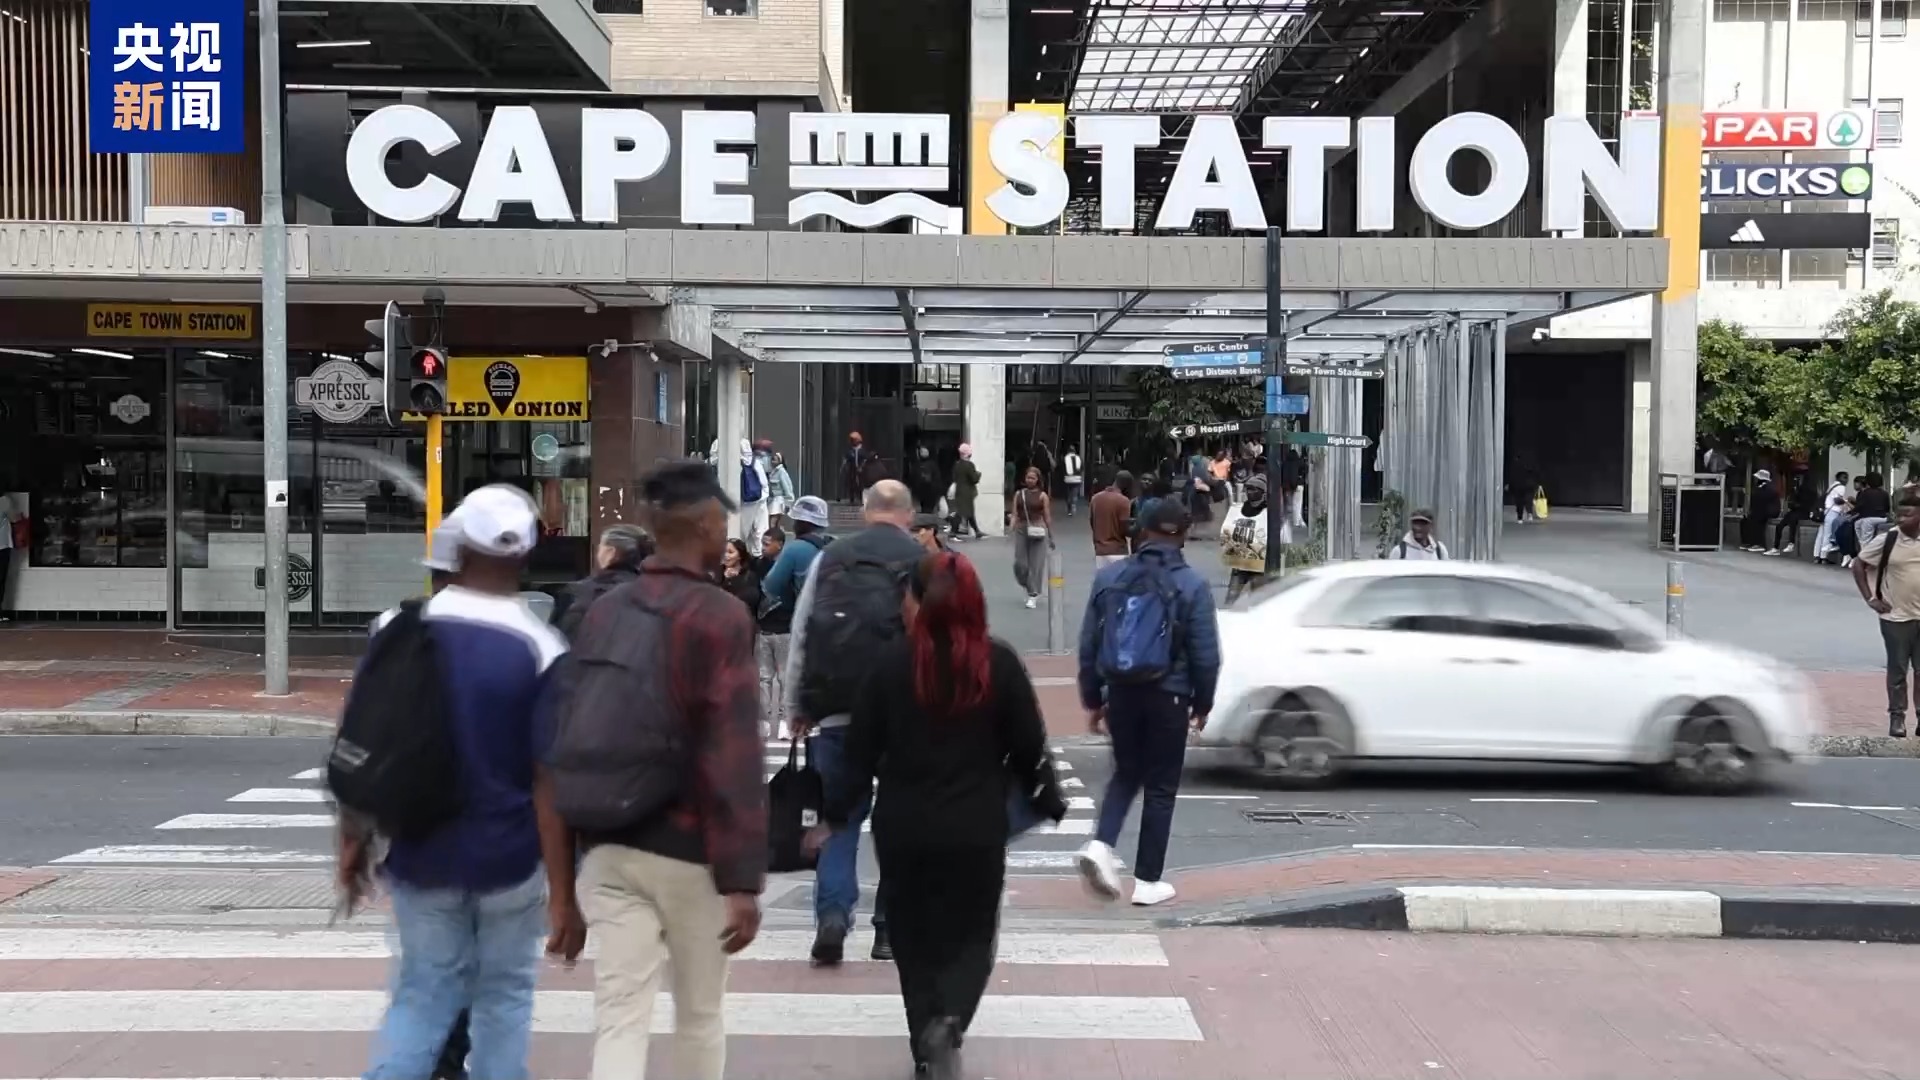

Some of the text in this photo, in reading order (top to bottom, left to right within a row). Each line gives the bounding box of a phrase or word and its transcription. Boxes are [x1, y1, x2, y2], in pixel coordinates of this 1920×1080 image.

[1700, 116, 1814, 142] PAR
[346, 104, 1660, 233] CAPE STATION
[1700, 167, 1838, 195] LICKS
[94, 311, 246, 331] CAPE TOWN STATION
[1193, 343, 1249, 353] Civic Centre
[1185, 367, 1204, 378] Long
[1206, 366, 1238, 376] Distance
[1289, 366, 1373, 377] Cape Town Stadium
[514, 402, 583, 417] ONION
[1200, 423, 1240, 434] Hospital
[1327, 436, 1367, 446] High Court
